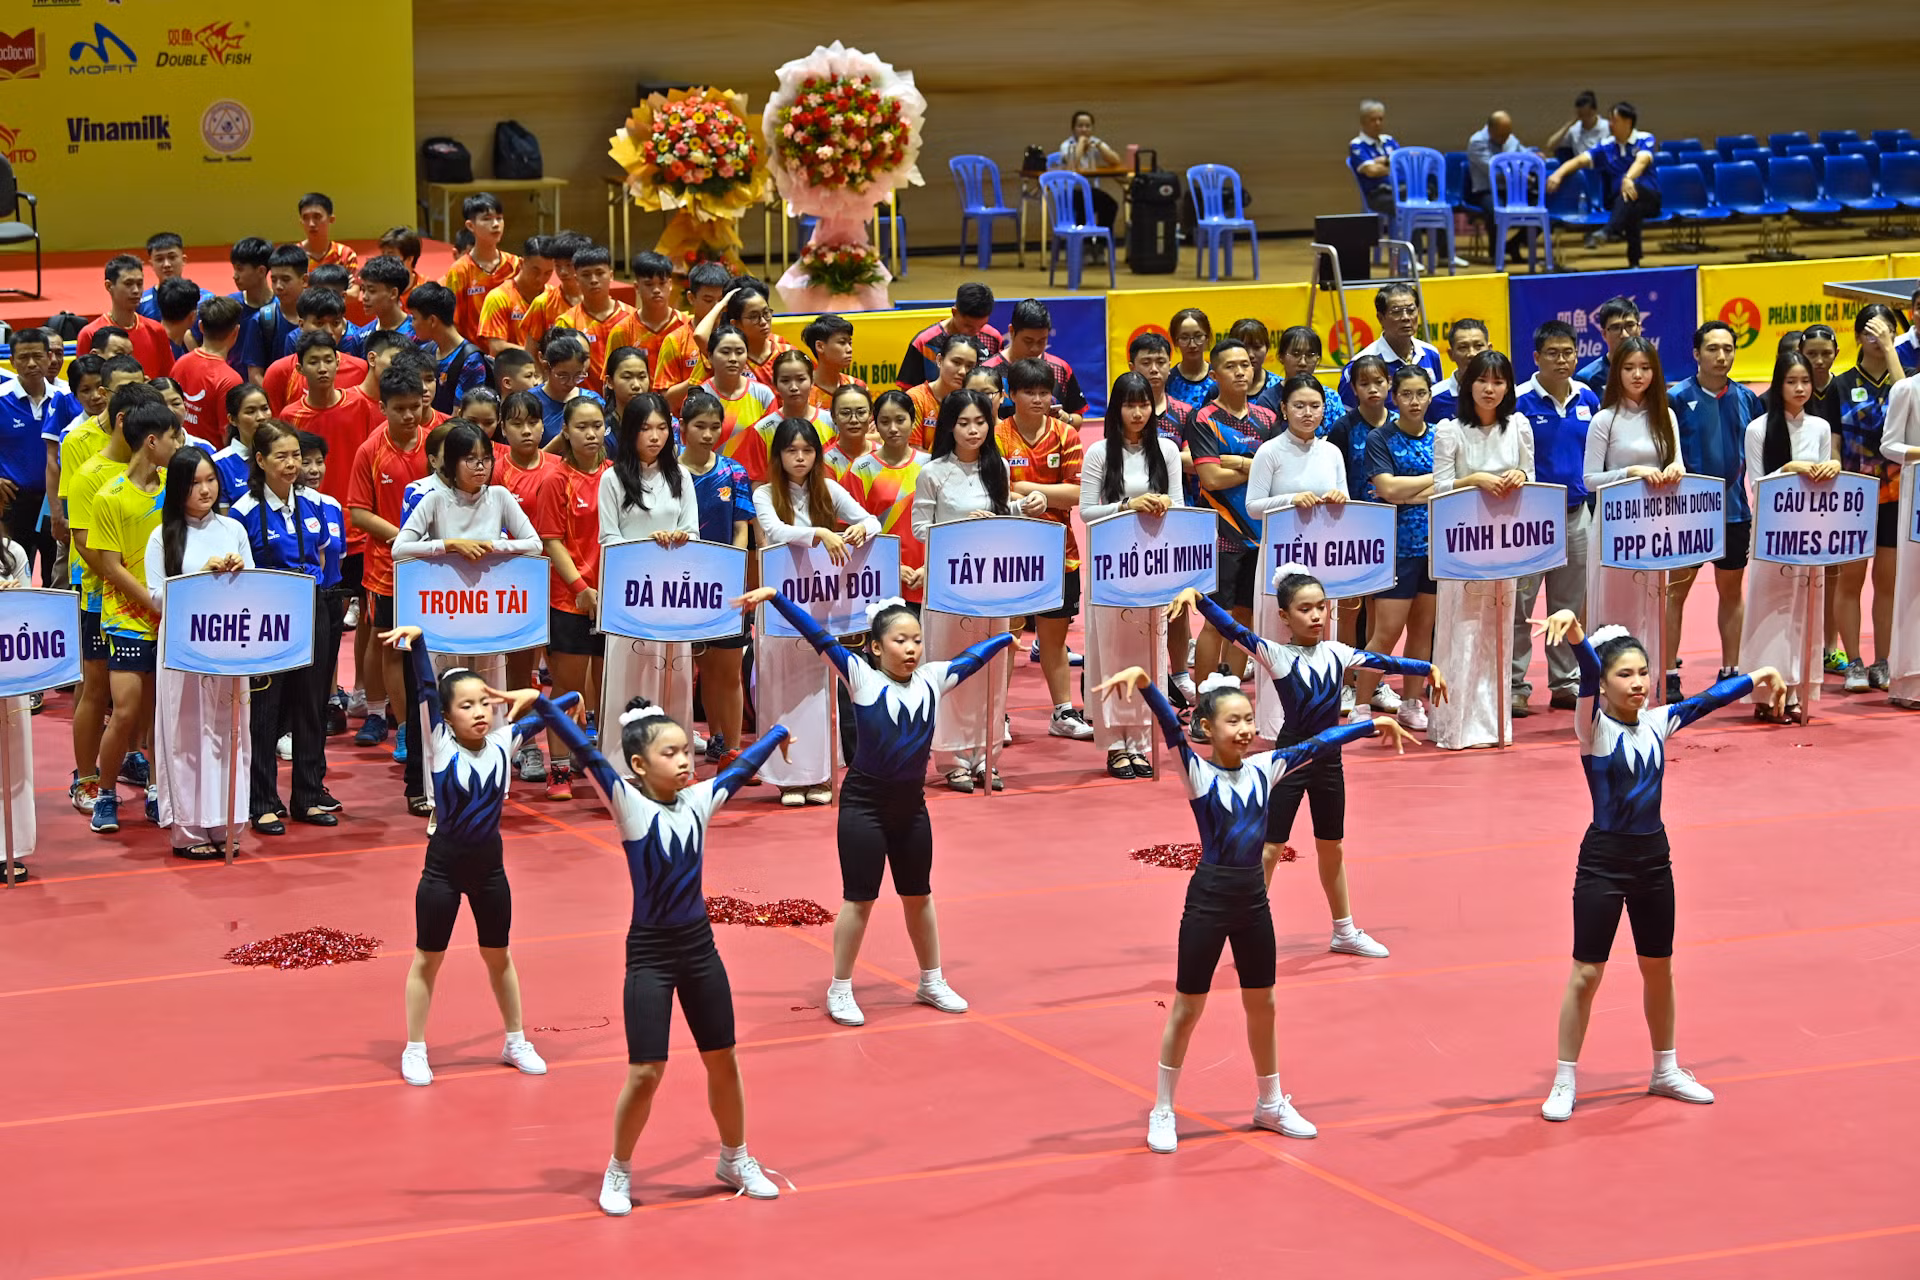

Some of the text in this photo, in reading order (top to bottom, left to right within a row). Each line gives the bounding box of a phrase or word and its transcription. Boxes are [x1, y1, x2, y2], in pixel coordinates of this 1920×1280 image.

[69, 64, 137, 75] MOFIT
[156, 52, 252, 67] DOUBLE FISH
[67, 115, 171, 142] Vinamilk
[68, 144, 79, 154] EST
[1768, 302, 1797, 325] PHÂN
[1801, 300, 1822, 322] BÓN
[872, 360, 897, 384] BÓN
[1605, 490, 1721, 524] CLB ĐẠI HỌC BÌNH DƯƠNG
[1774, 487, 1864, 517] CÂU LẠC BỘ
[1274, 534, 1385, 568] TIỀN GIANG
[1446, 520, 1555, 553] VĨNH LONG
[1614, 526, 1714, 561] PPP CÀ MAU
[1765, 530, 1868, 555] TIMES CITY
[948, 552, 1044, 584] TÂY NINH
[1094, 542, 1213, 581] TP. HỒ CHÍ MINH
[625, 571, 723, 609] ĐÀ NẴNG
[846, 566, 881, 604] ĐỘI
[419, 585, 528, 620] TRỌNG TÀI
[0, 622, 66, 662] ĐỒNG
[190, 608, 290, 648] NGHỆ AN
